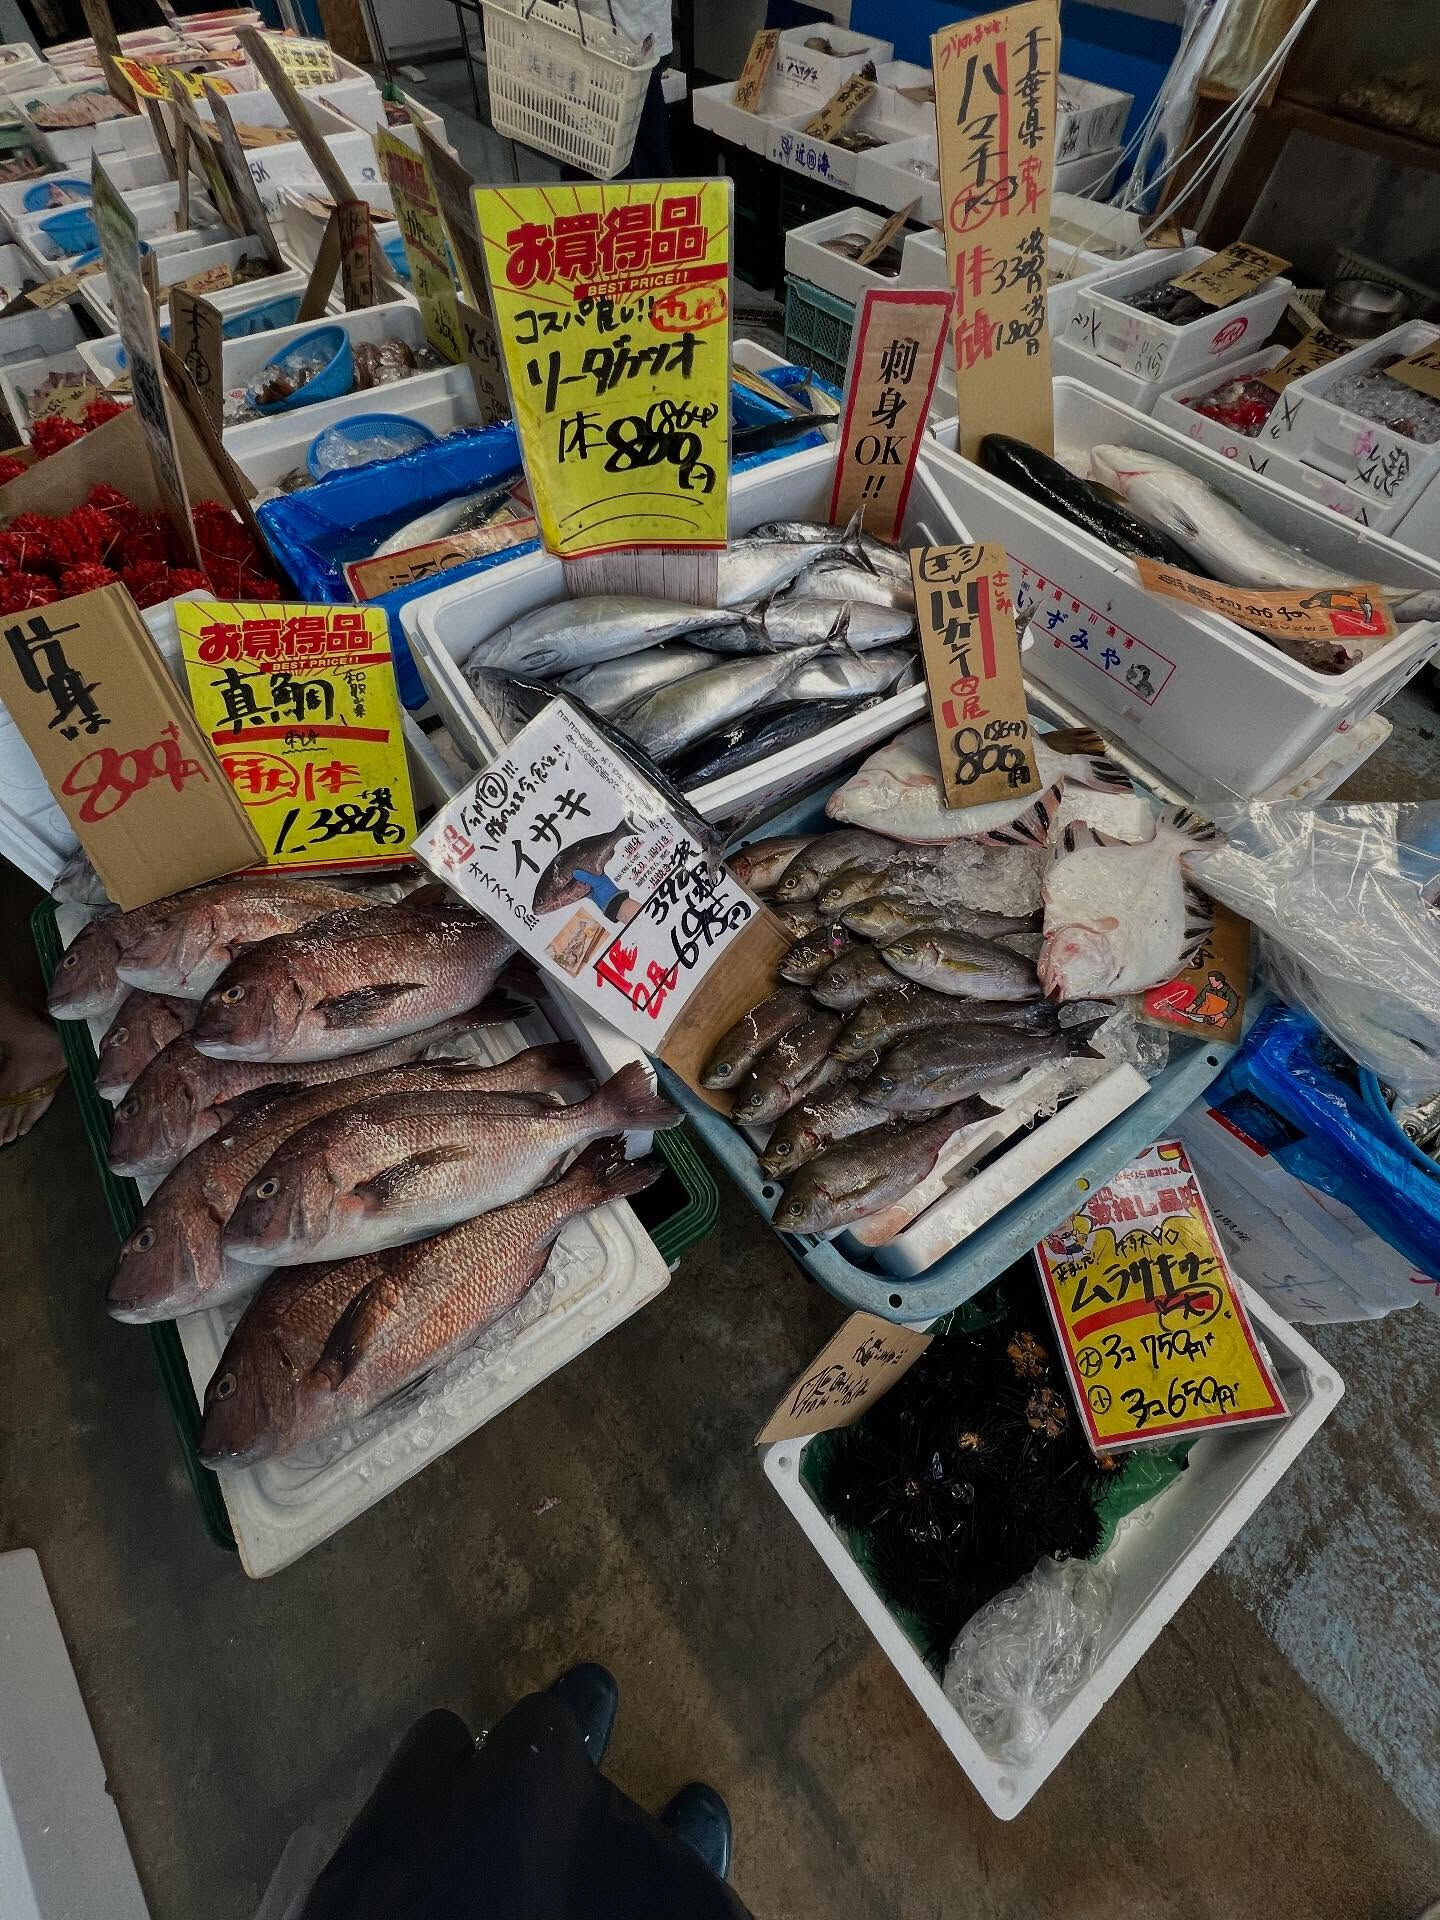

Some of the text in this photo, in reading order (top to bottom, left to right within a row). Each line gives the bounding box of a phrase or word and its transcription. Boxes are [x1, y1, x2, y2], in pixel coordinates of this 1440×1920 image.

[957, 54, 1008, 188] ハマチ
[506, 196, 708, 290] お買得品
[588, 273, 690, 298] BEST PRICE!!
[198, 613, 373, 665] お買得品
[272, 657, 359, 672] BEST PRICE!!
[210, 668, 335, 735] 真鯛
[512, 789, 591, 879] イサキ
[468, 861, 540, 932] オススメの魚
